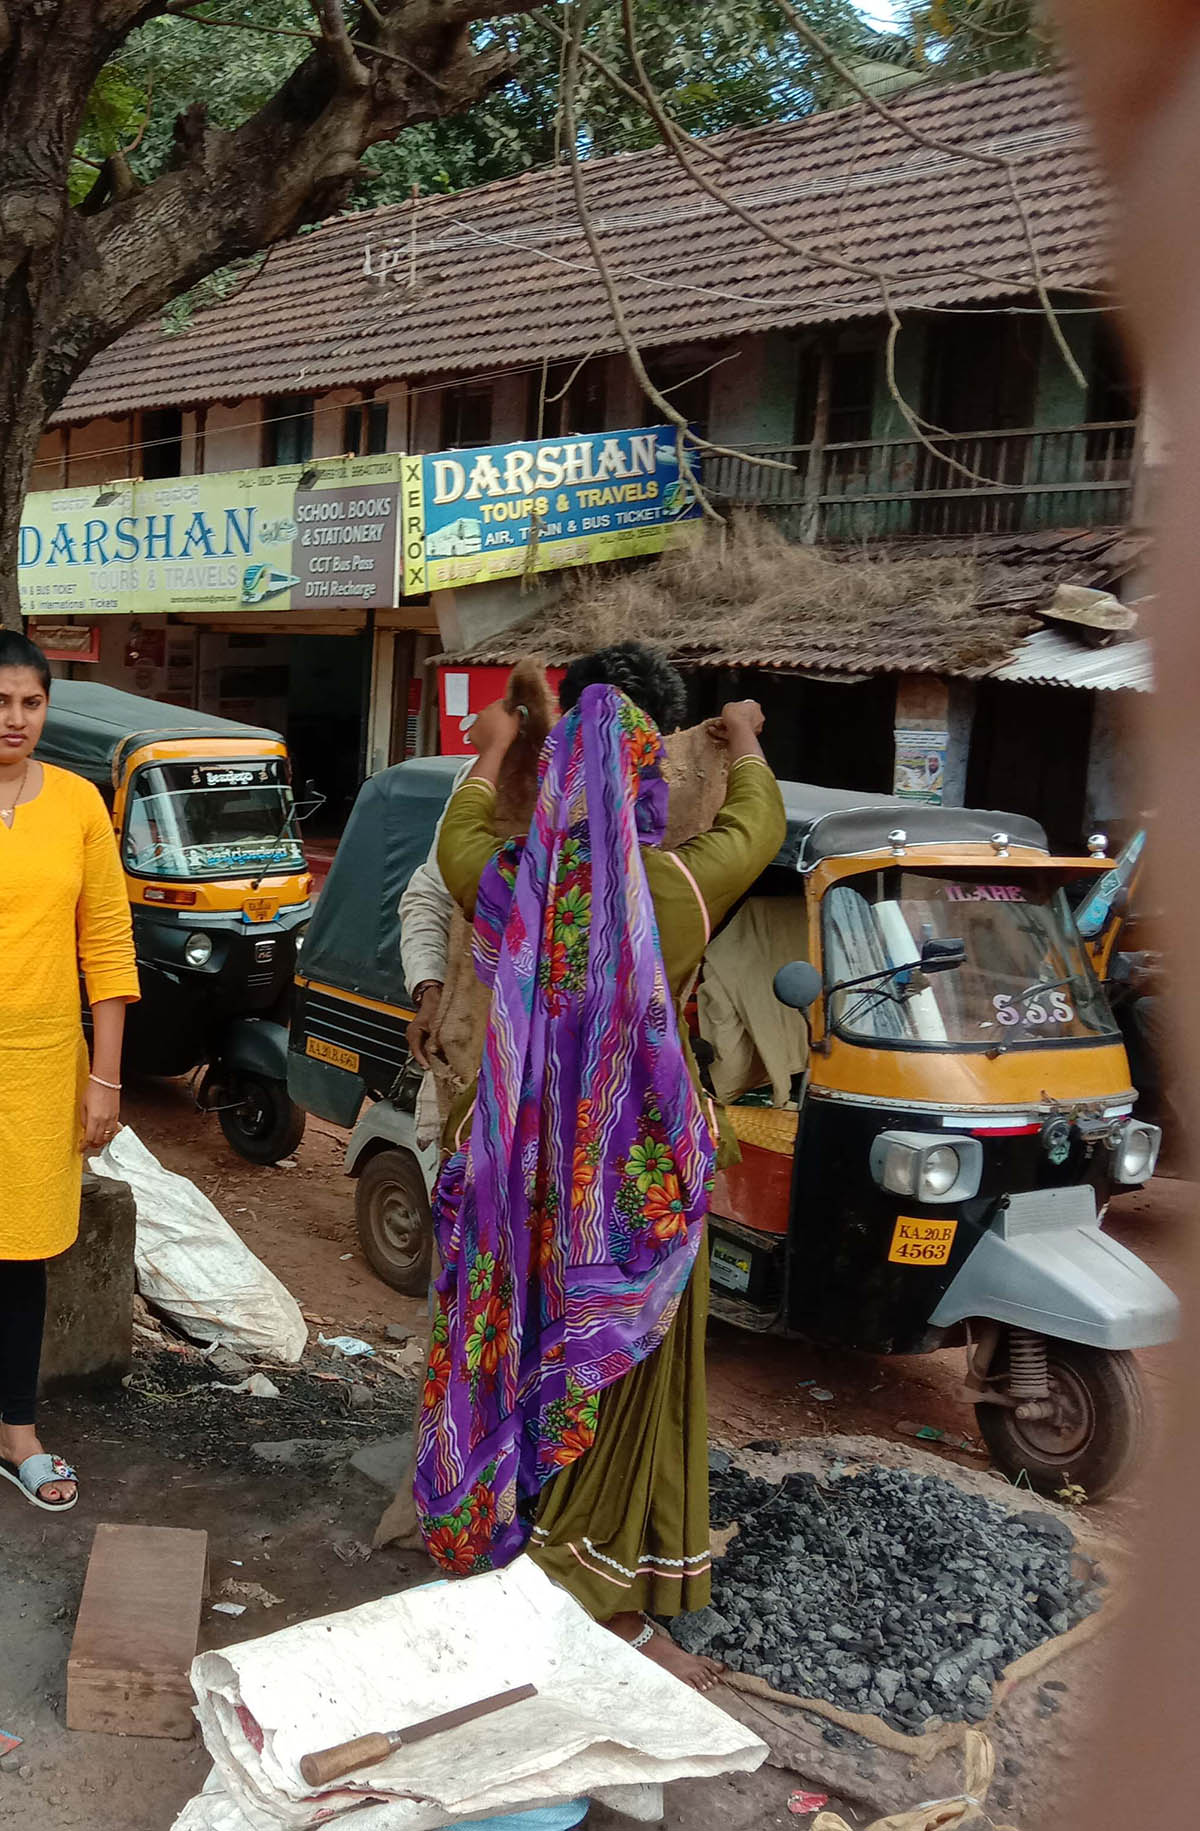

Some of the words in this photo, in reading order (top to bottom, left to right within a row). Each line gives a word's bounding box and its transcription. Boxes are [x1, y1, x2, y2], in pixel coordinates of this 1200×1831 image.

[431, 434, 659, 505] DARSHAN
[296, 501, 346, 523] SCHOOL
[348, 497, 392, 519] BOOKS
[480, 496, 550, 524] TOURS
[556, 494, 570, 513] &
[576, 480, 659, 509] TRAVELS
[18, 505, 258, 569] DARSHAN
[301, 530, 312, 547] &
[313, 523, 386, 546] STATIONERY
[406, 463, 425, 586] XEROX
[485, 530, 515, 547] AIR,
[519, 522, 562, 541] TAIN
[567, 520, 577, 533] &
[582, 514, 611, 531] BUS
[615, 506, 664, 525] TICKET
[90, 566, 140, 592] TOURS
[164, 561, 240, 591] TRAVELS
[309, 556, 332, 574] CCT
[332, 556, 351, 572] Bus
[352, 554, 376, 571] Pass
[88, 598, 119, 609] Tickets
[305, 582, 330, 599] DTH
[330, 580, 378, 600] Recharge
[895, 1243, 947, 1259] 4563
